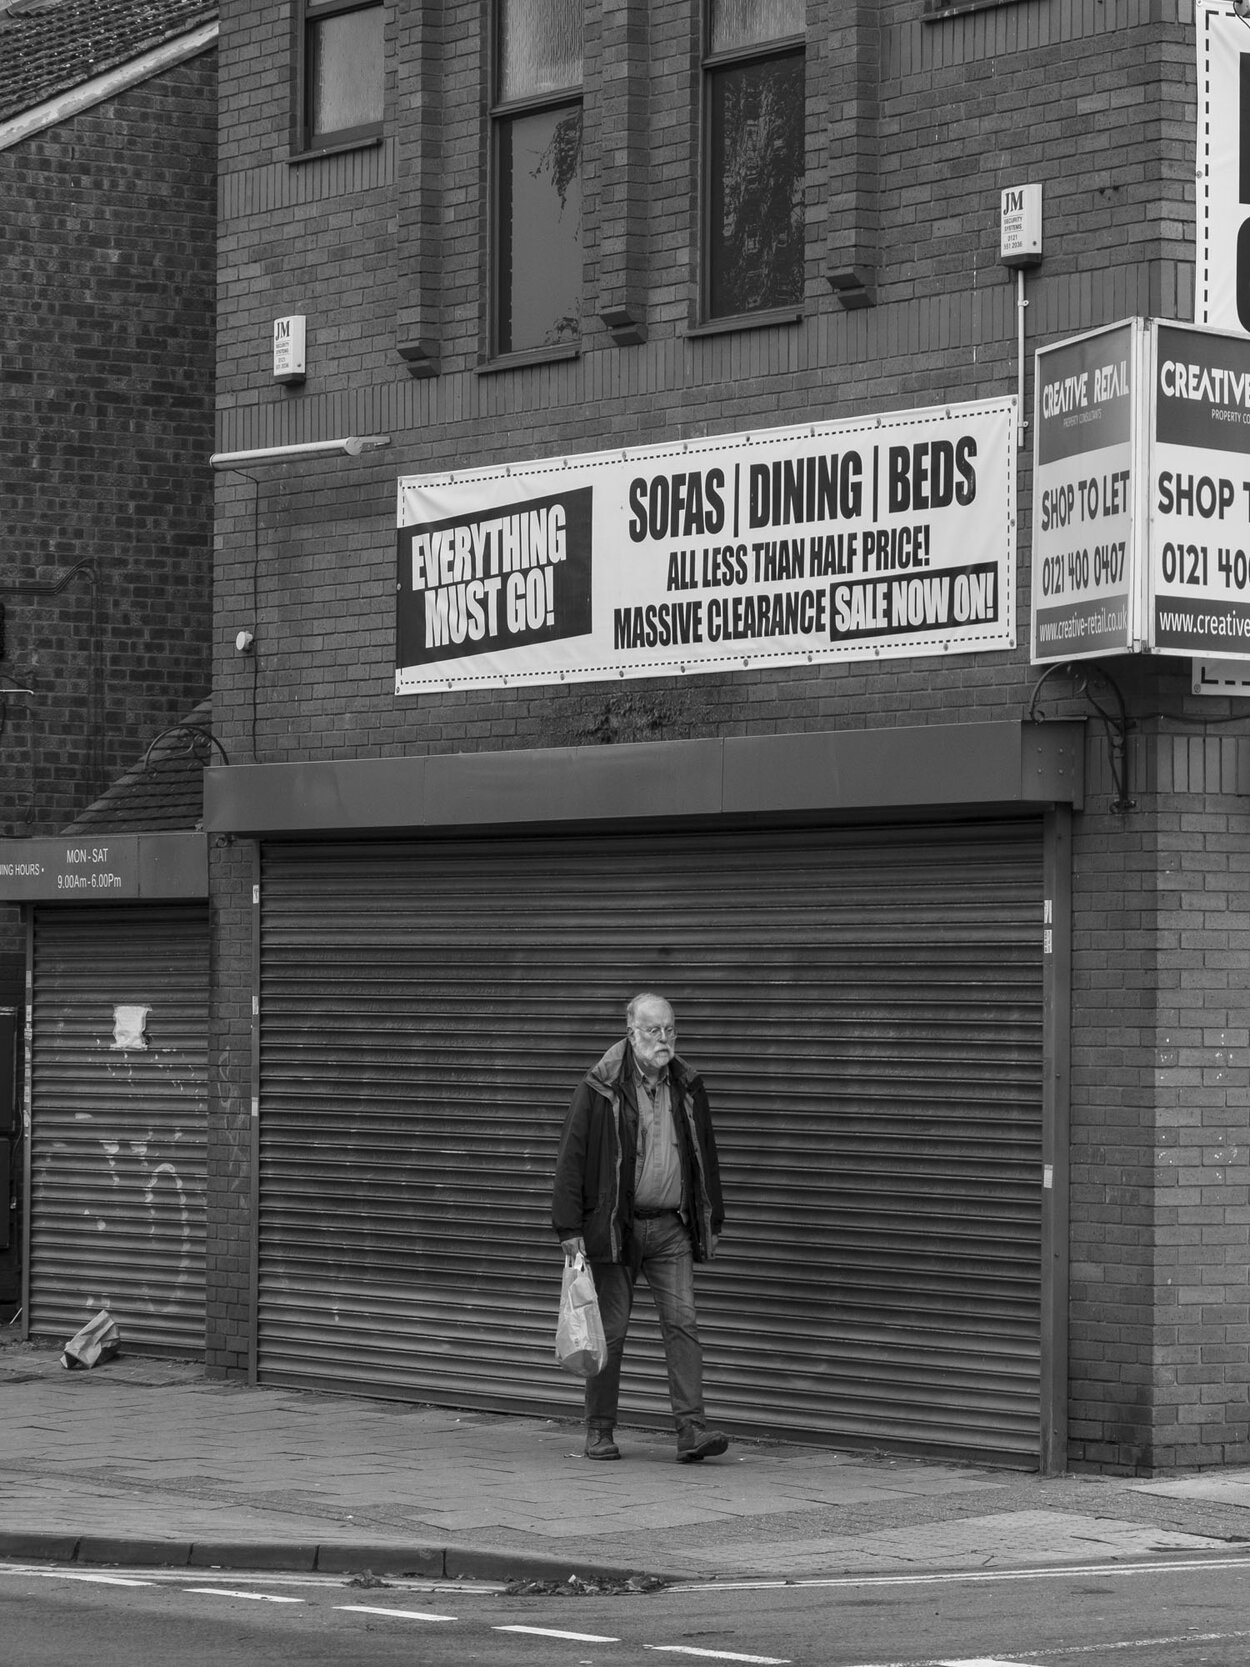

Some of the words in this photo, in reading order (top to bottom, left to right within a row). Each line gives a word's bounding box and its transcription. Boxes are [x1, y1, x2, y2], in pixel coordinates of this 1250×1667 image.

[1003, 190, 1024, 215] JM
[275, 320, 290, 341] JM
[1043, 372, 1088, 420] CREATIVE
[1094, 360, 1130, 404] RETAIL
[1211, 408, 1242, 425] PROPERTY
[629, 467, 725, 544] SOFAS
[750, 450, 863, 527] DINING
[889, 436, 978, 511] BEDS
[1041, 484, 1075, 532] SHOP
[1078, 477, 1099, 522] TO
[1103, 470, 1130, 517] LET
[1158, 471, 1235, 520] SHOP
[412, 504, 567, 592] EVERYTHING
[667, 550, 699, 592] ALL
[702, 544, 749, 588] LESS
[752, 537, 808, 583] THAN
[810, 534, 857, 577] HALF
[861, 525, 931, 572] PRICE!
[1042, 554, 1065, 597] 0121
[1068, 548, 1090, 591] 400
[1094, 541, 1126, 587] 0407
[1162, 542, 1208, 586] 0121
[425, 580, 502, 650] MUST
[507, 566, 556, 630] GO!
[614, 601, 702, 650] MASSIVE
[707, 589, 826, 641] CLEARANCE
[835, 579, 891, 632] SALE
[892, 573, 953, 627] NOW
[954, 571, 996, 622] ON!
[1039, 604, 1128, 642] www.creative-retail.co.uk
[15, 863, 40, 876] HOURS
